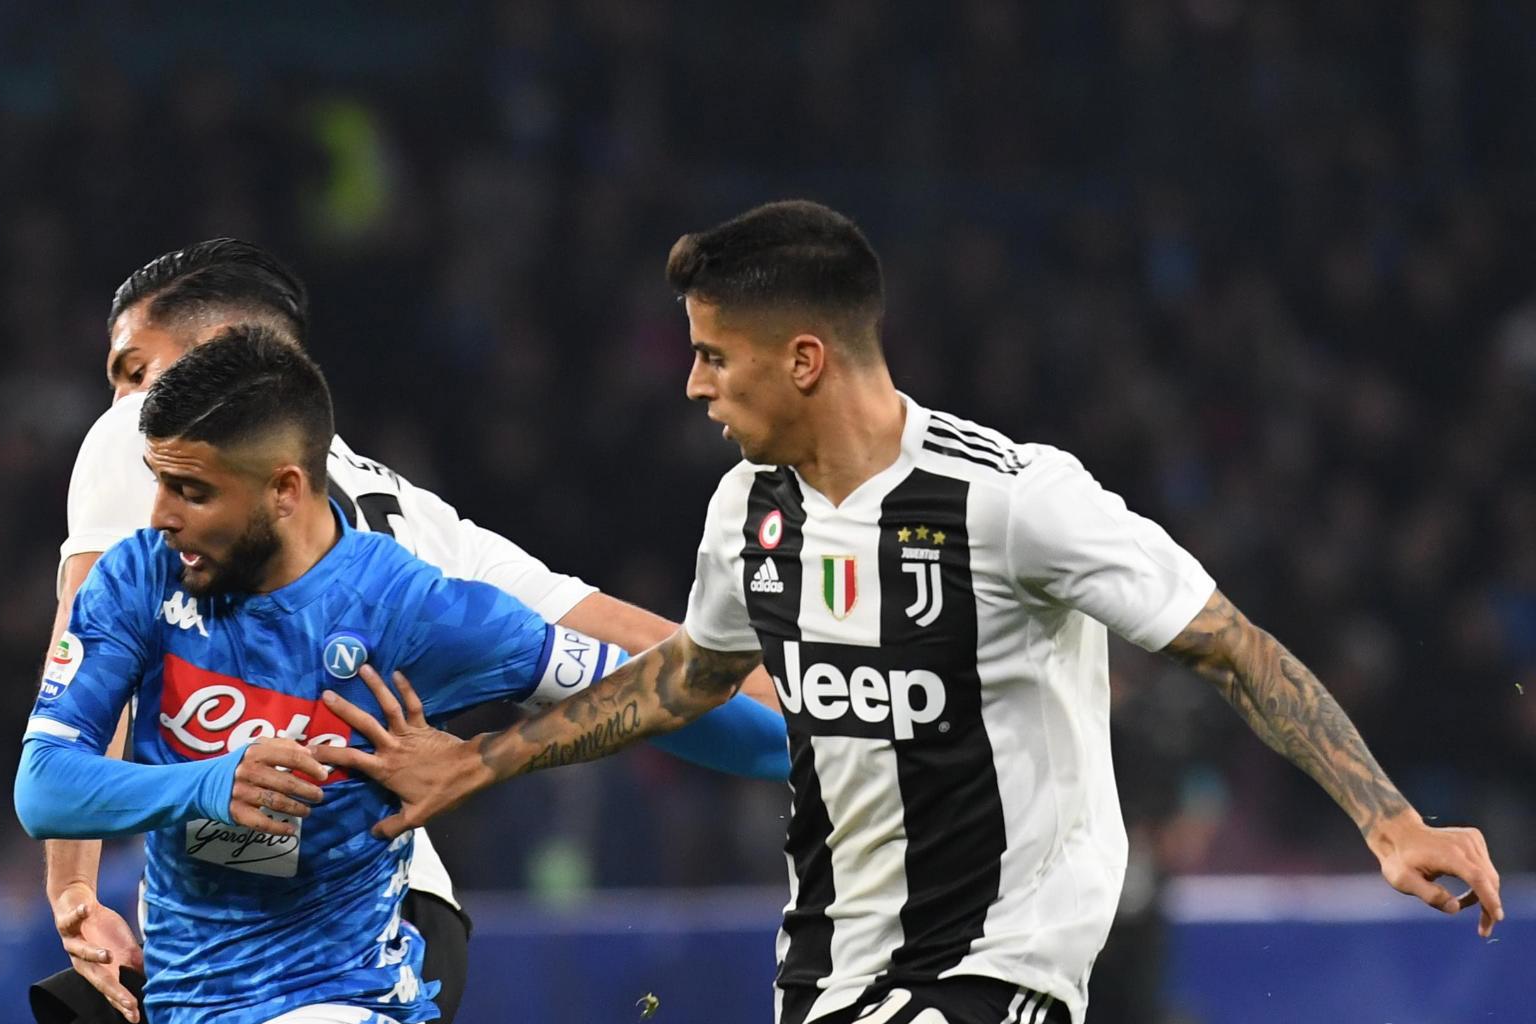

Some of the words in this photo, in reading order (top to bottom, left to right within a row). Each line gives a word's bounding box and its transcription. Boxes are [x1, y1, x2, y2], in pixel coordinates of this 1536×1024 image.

[750, 579, 784, 593] adidas
[330, 643, 360, 672] N
[773, 640, 947, 741] Jeep
